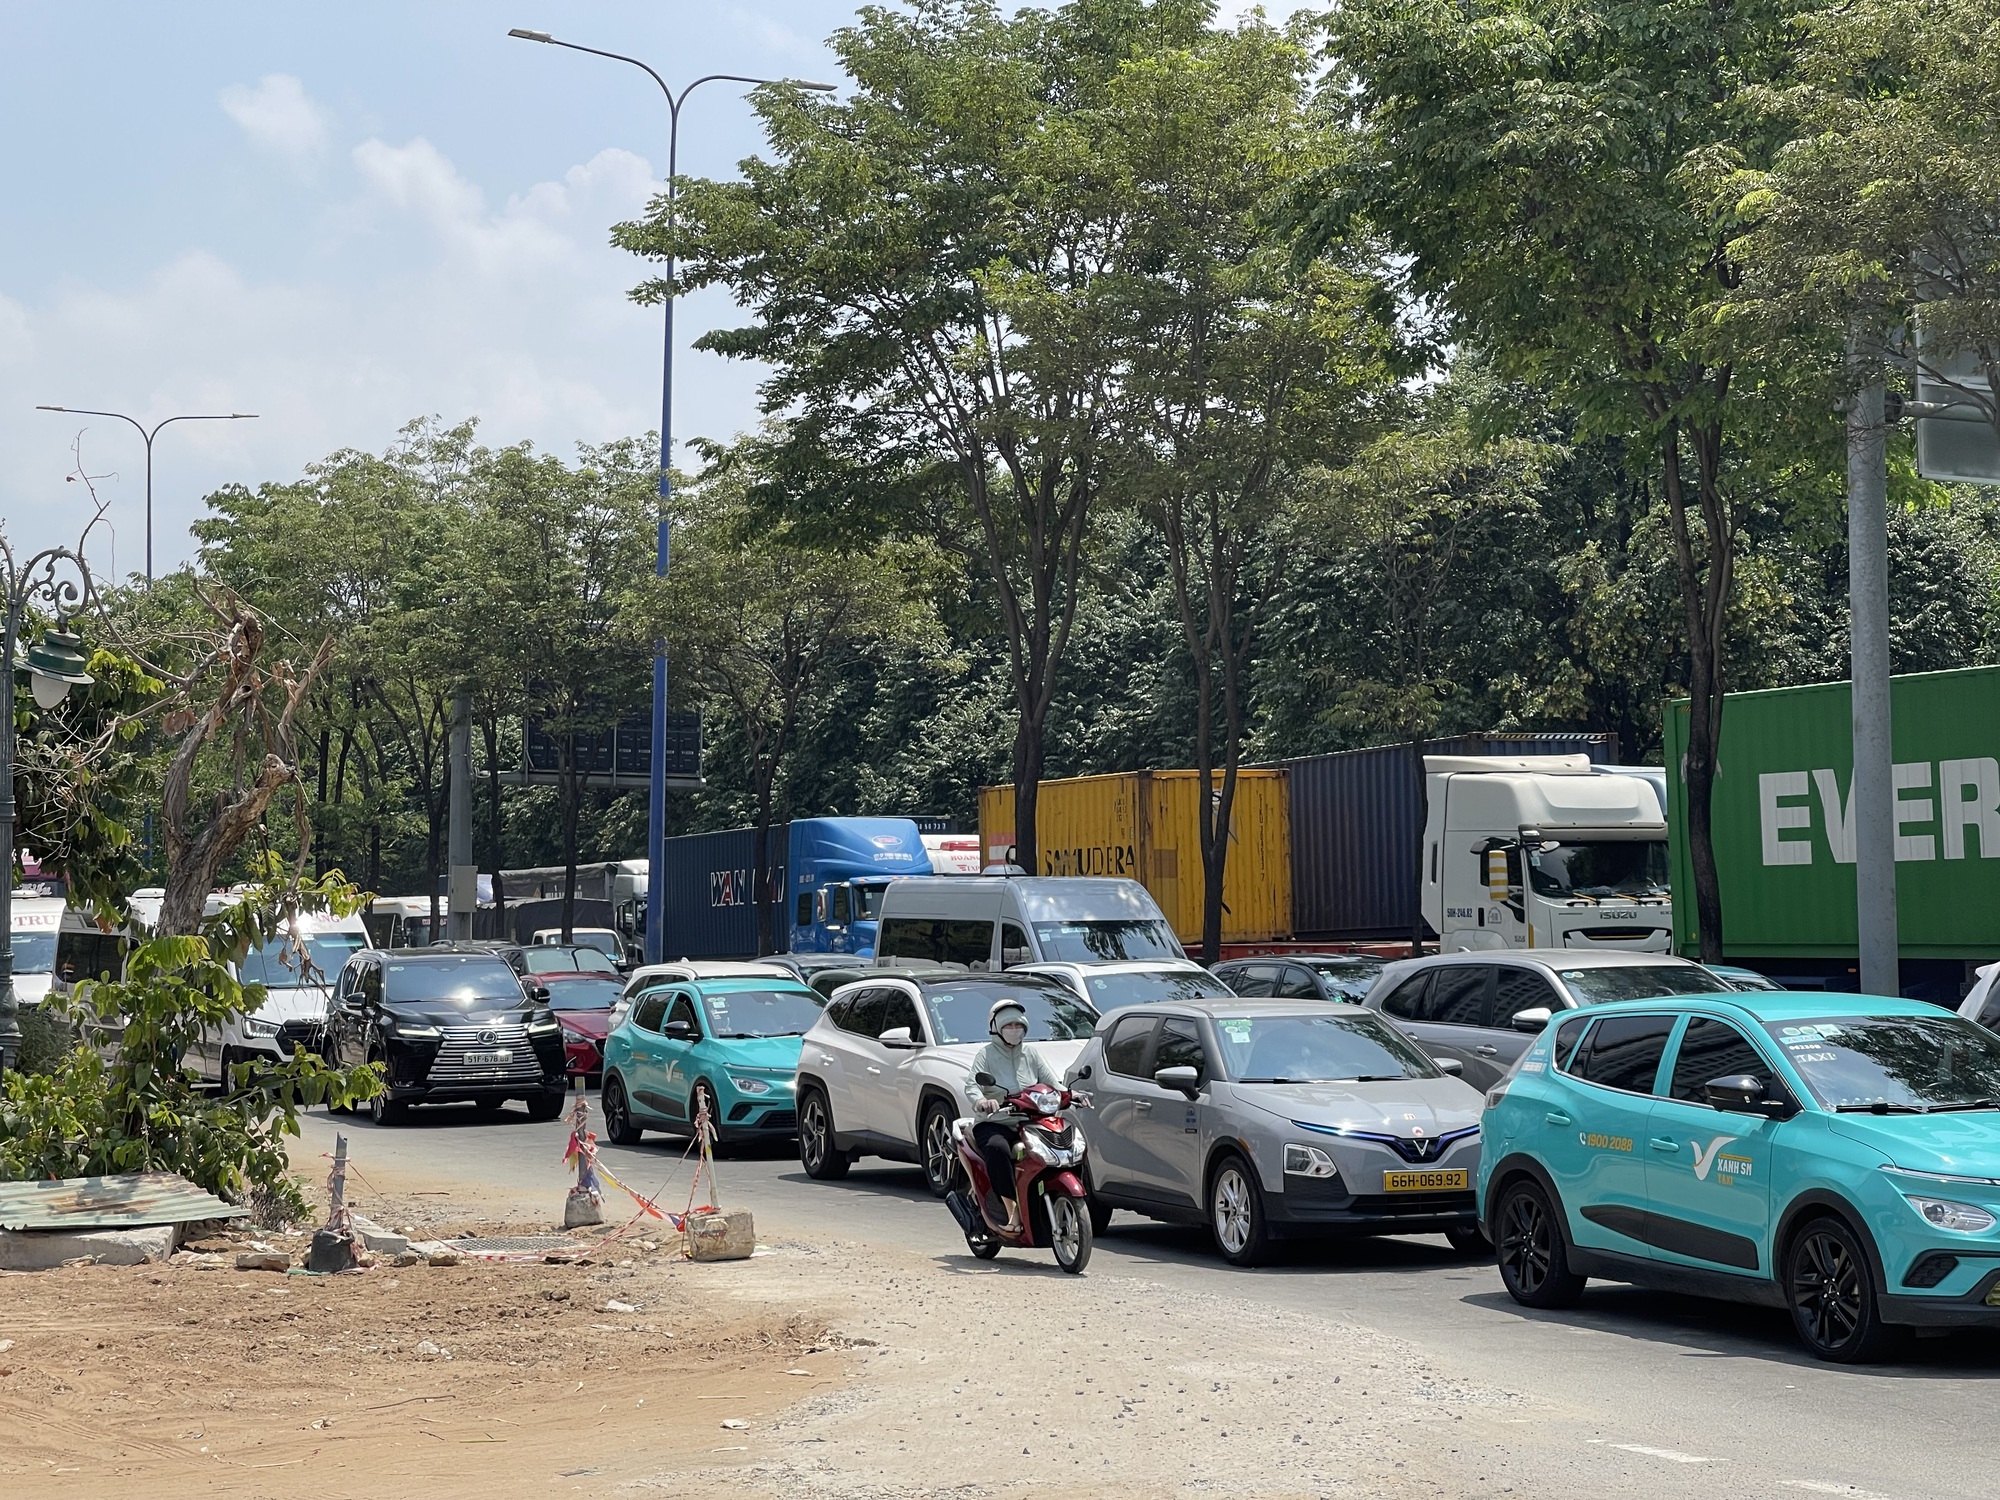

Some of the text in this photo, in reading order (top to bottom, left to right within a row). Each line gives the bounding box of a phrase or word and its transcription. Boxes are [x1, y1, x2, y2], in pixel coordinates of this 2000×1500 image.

[1599, 910, 1638, 920] ISUZU
[1799, 1052, 1835, 1063] TAXI
[1587, 1133, 1633, 1152] 1900 2088
[1717, 1159, 1740, 1174] XANH
[1391, 1173, 1461, 1188] 66H-069.92
[1717, 1173, 1734, 1185] TAXI
